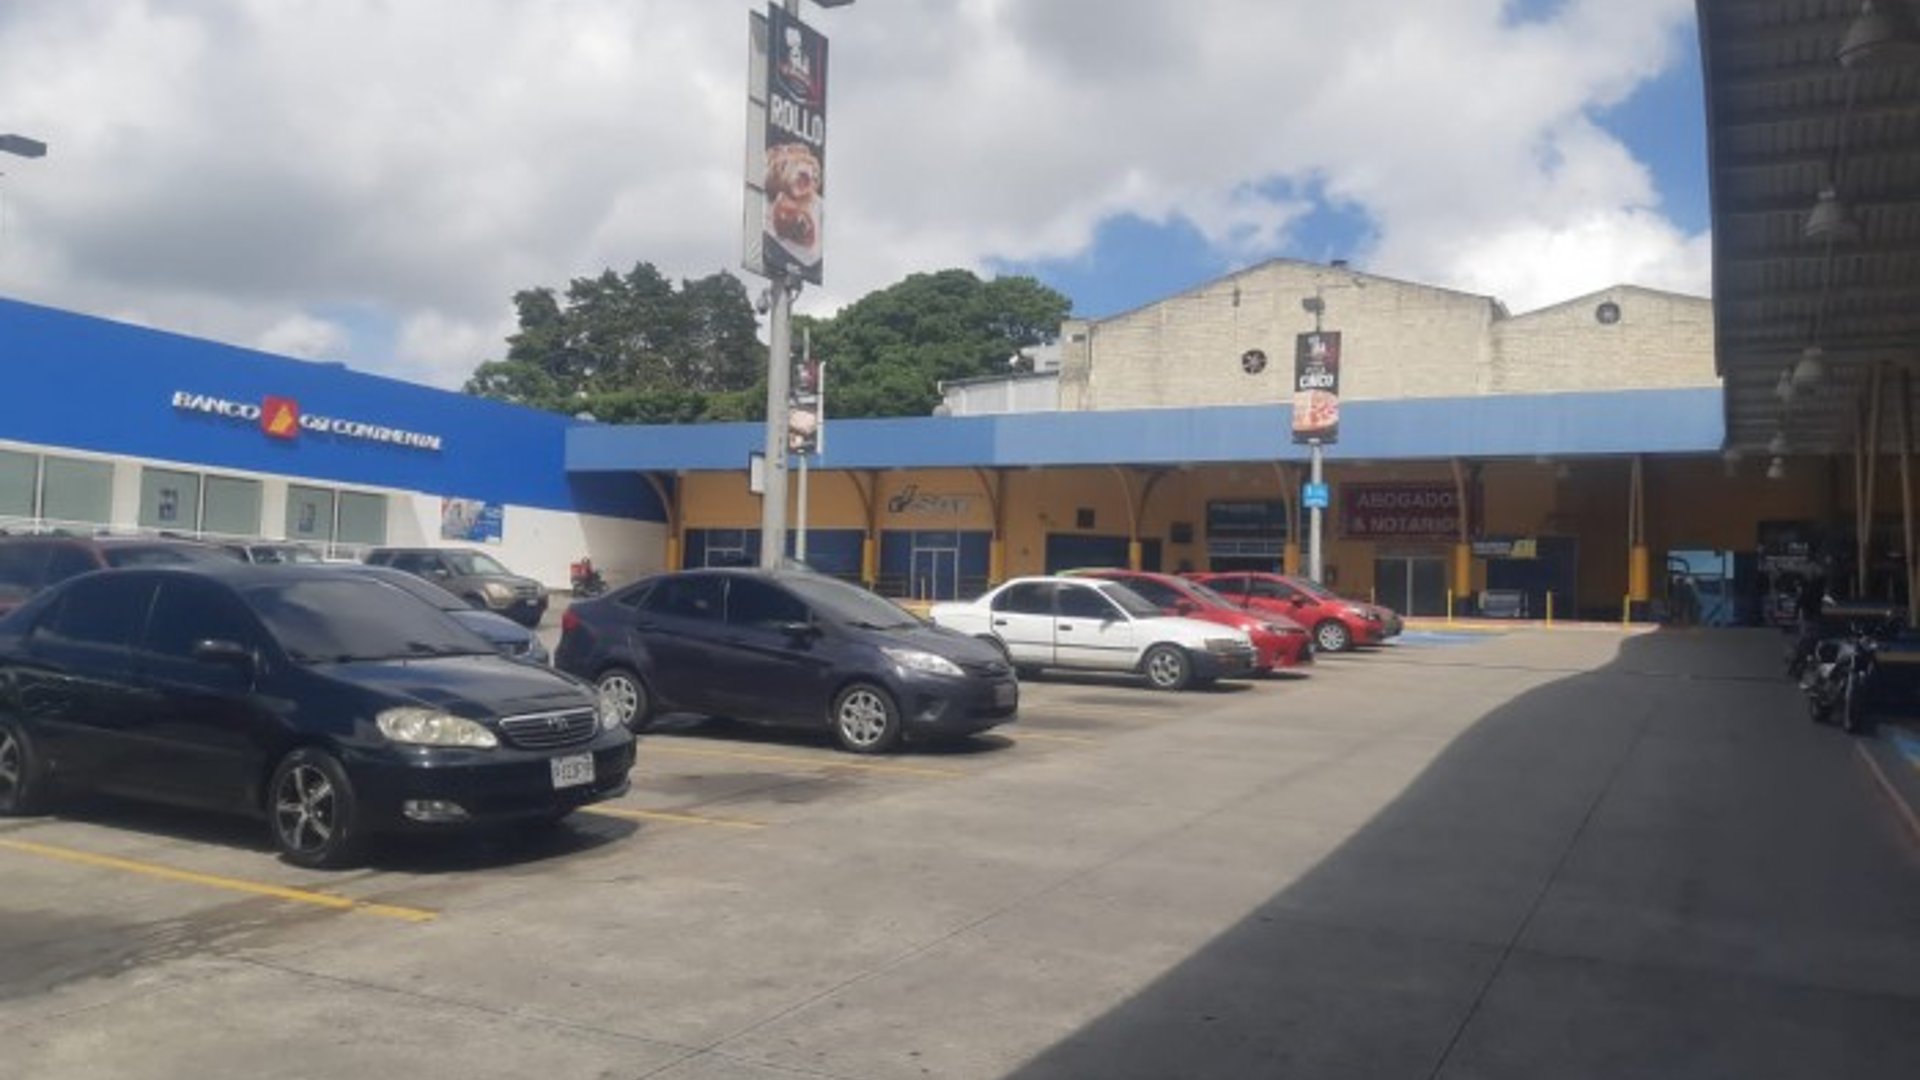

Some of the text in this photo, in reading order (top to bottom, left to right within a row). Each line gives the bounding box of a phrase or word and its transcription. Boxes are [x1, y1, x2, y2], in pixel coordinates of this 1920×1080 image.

[770, 94, 824, 144] ROLLO
[172, 391, 261, 420] BANCO
[332, 419, 443, 450] CONTINENTAL
